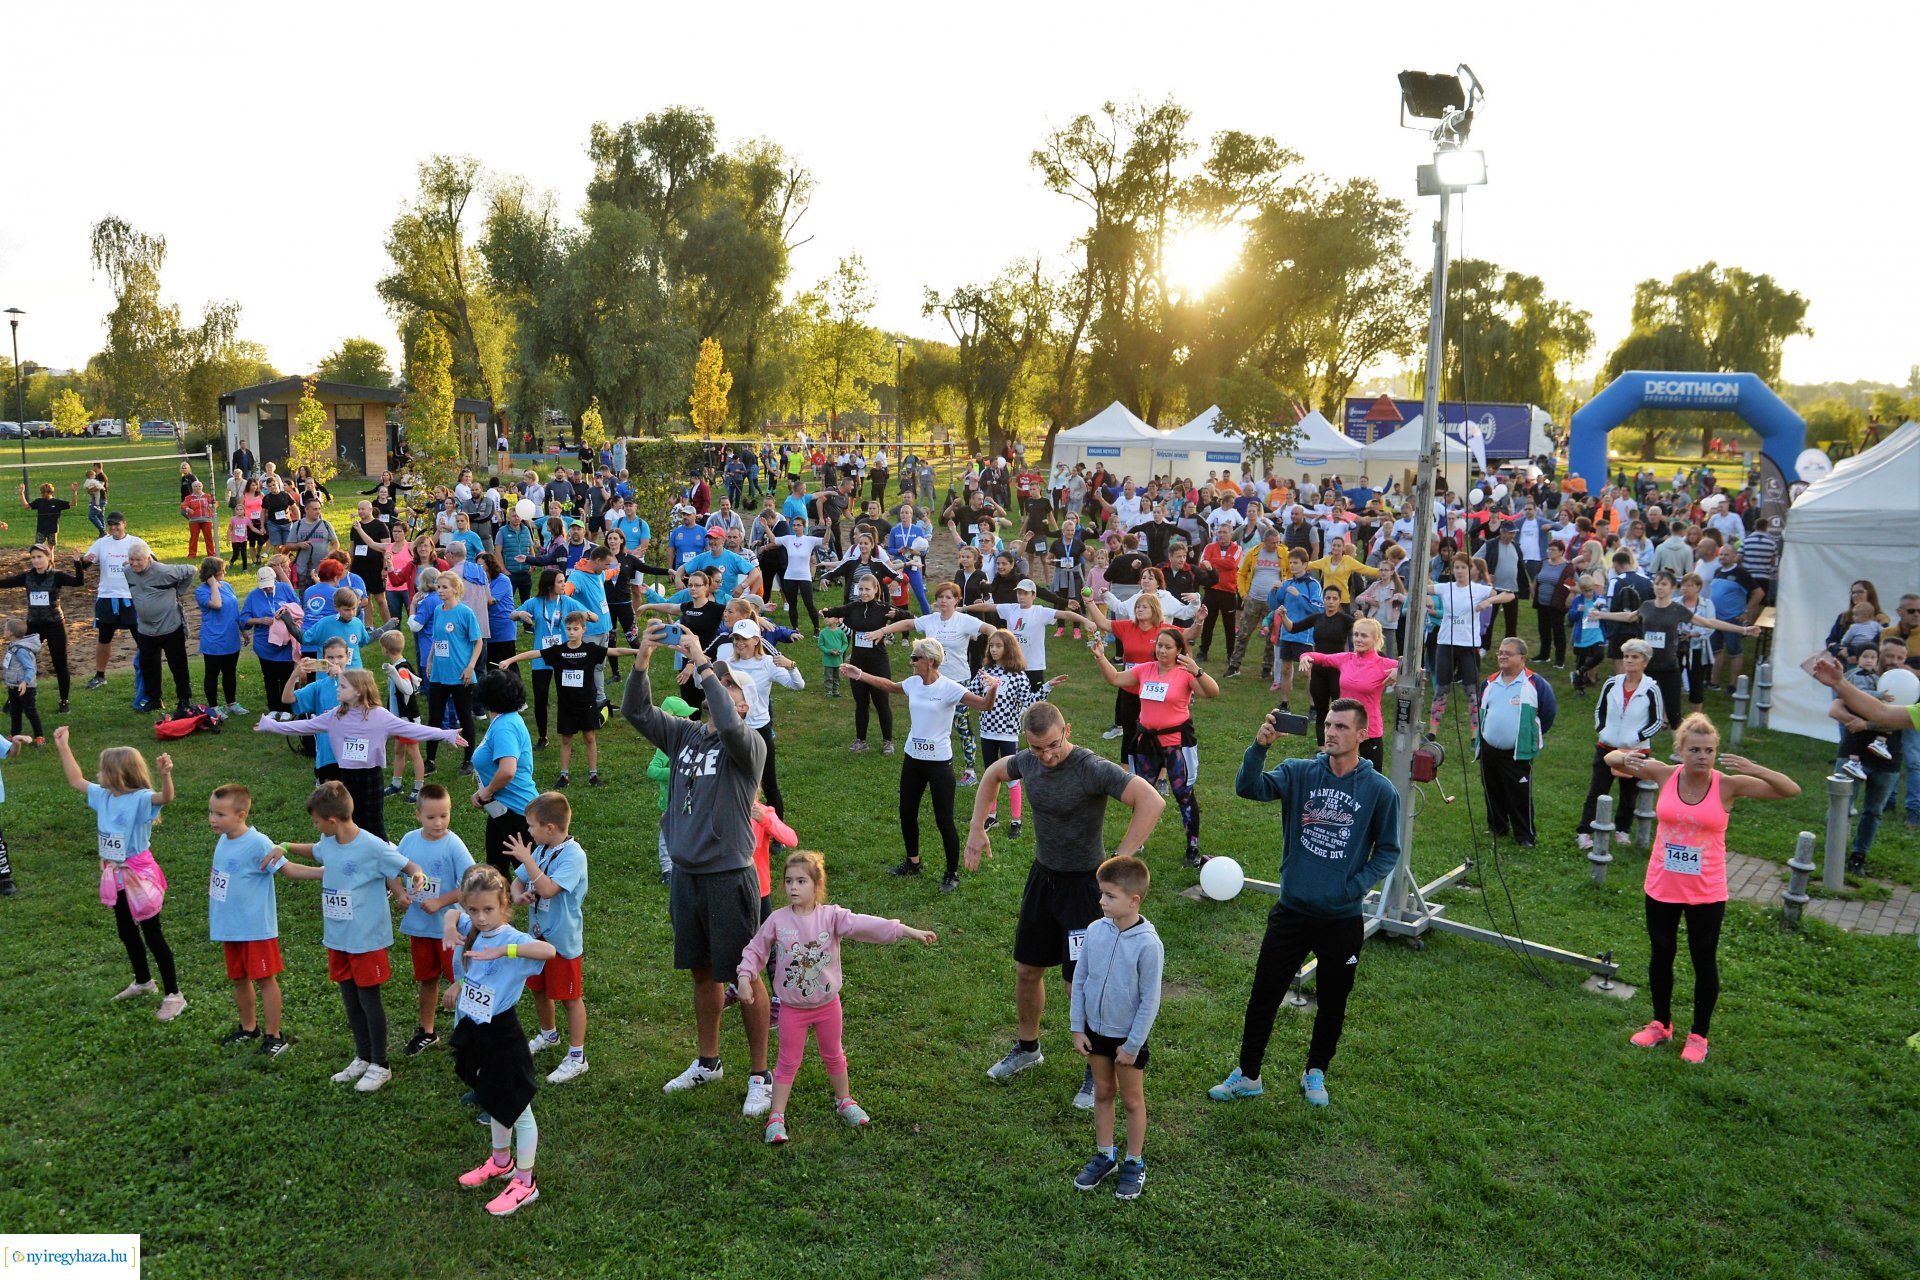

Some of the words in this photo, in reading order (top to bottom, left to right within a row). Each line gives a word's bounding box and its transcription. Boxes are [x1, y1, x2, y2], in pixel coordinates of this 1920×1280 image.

[1645, 381, 1739, 396] DECATHLON
[1146, 685, 1165, 694] 1355
[346, 742, 365, 752] 1719
[913, 742, 935, 751] 1308
[1309, 788, 1361, 812] MANHATTAN
[100, 837, 121, 849] 1746
[1300, 835, 1328, 858] COLLEGE
[1330, 850, 1347, 859] DIV.
[1331, 838, 1347, 848] SPORT
[1667, 850, 1699, 863] 1484
[325, 895, 348, 907] 1415
[465, 985, 491, 1007] 1622
